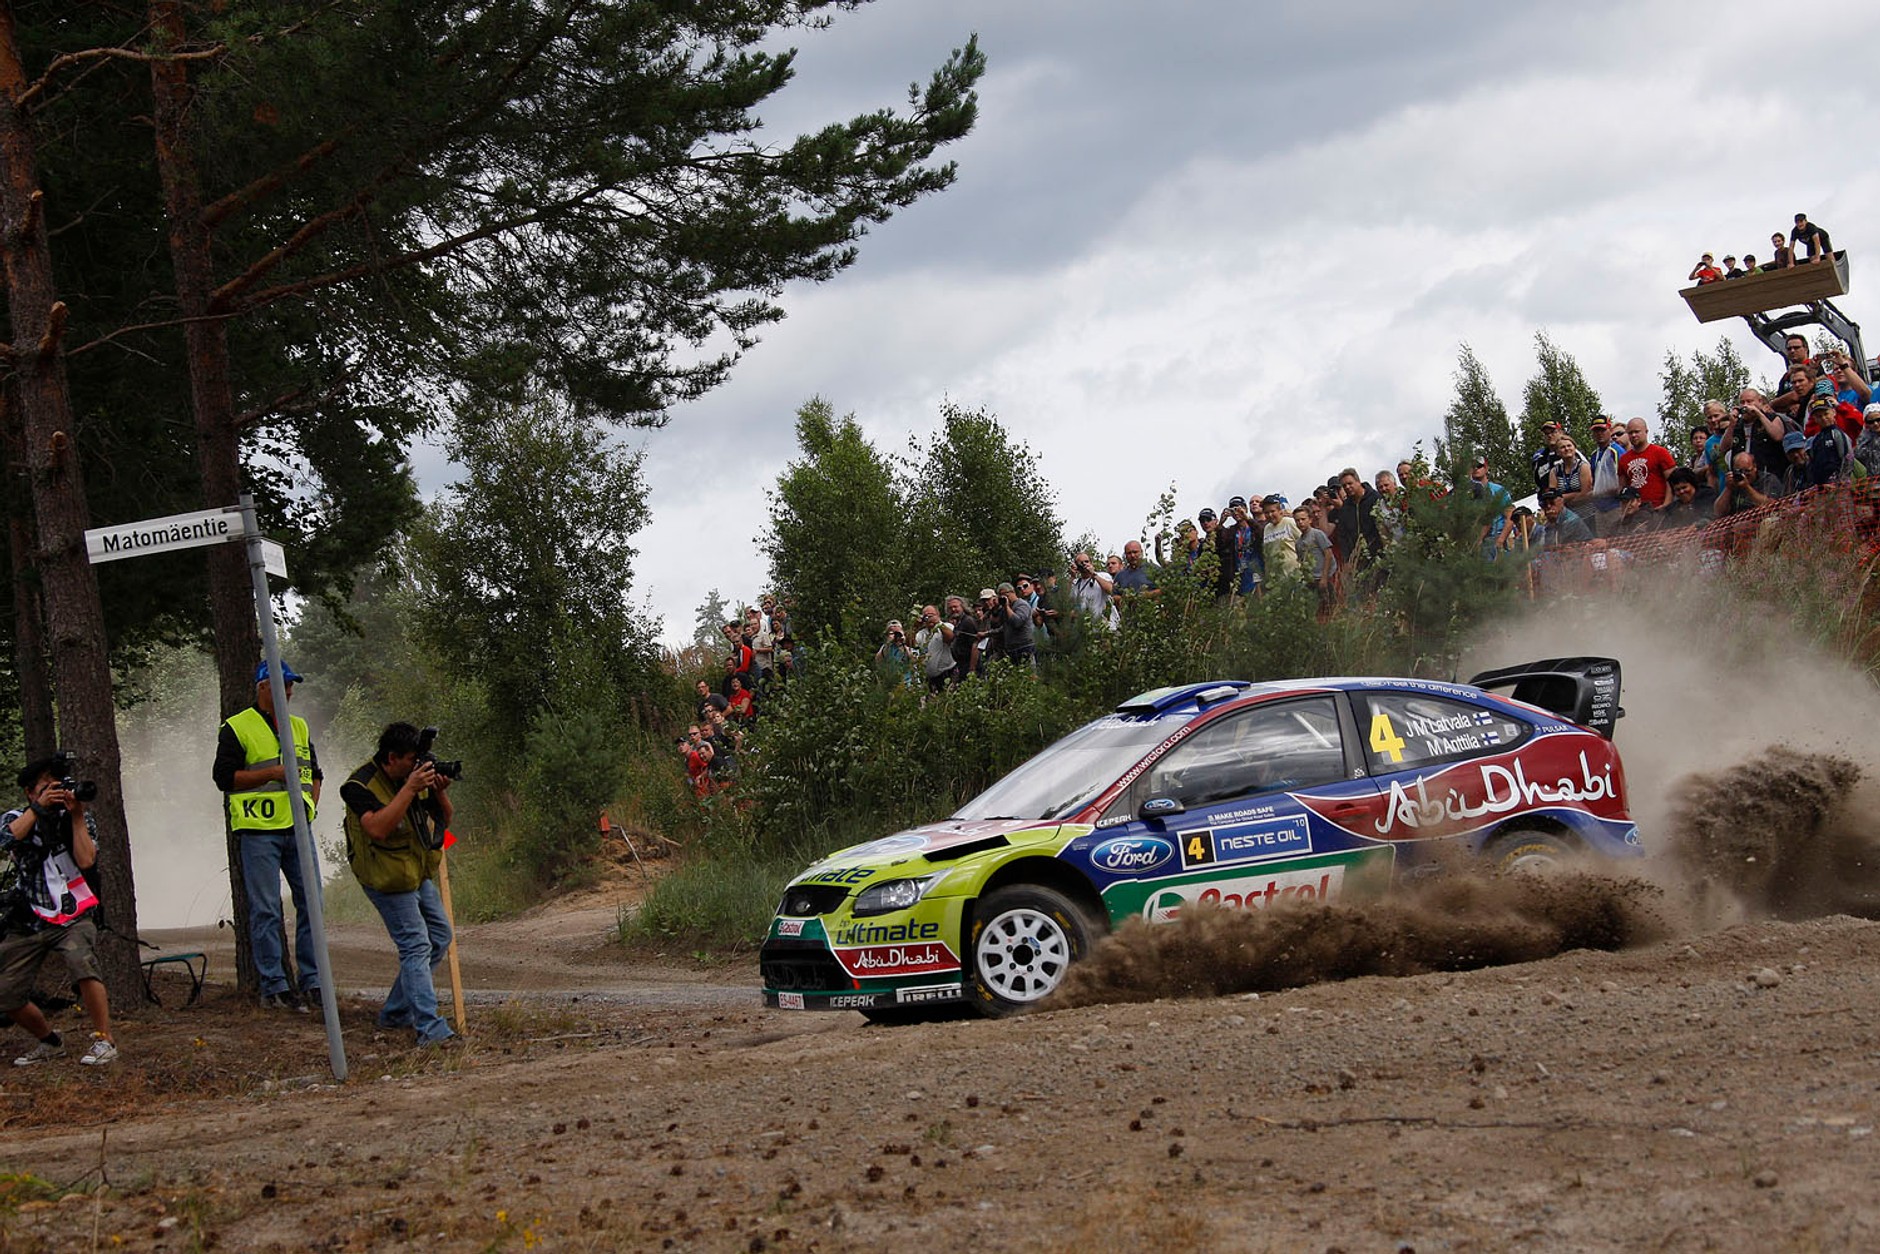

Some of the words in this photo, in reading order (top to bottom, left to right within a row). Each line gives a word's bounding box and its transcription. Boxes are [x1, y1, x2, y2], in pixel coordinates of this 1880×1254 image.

[103, 518, 228, 553] Matomäentie
[1369, 713, 1405, 762] 4
[1406, 721, 1415, 738] J
[1415, 719, 1427, 737] M
[1427, 713, 1471, 734] Latvala
[1117, 726, 1192, 788] www.wrcford.com
[1426, 740, 1442, 756] M
[1442, 735, 1481, 754] Anttila
[1214, 811, 1233, 820] MAKE
[1233, 808, 1257, 818] ROADS
[1257, 806, 1275, 814] SAFE
[1187, 836, 1206, 861] 4
[1277, 829, 1302, 843] OIL
[1106, 840, 1158, 869] Ford
[836, 918, 940, 944] ultimate
[829, 995, 876, 1008] ICEPEAK
[896, 982, 962, 1004] PIRELLI
